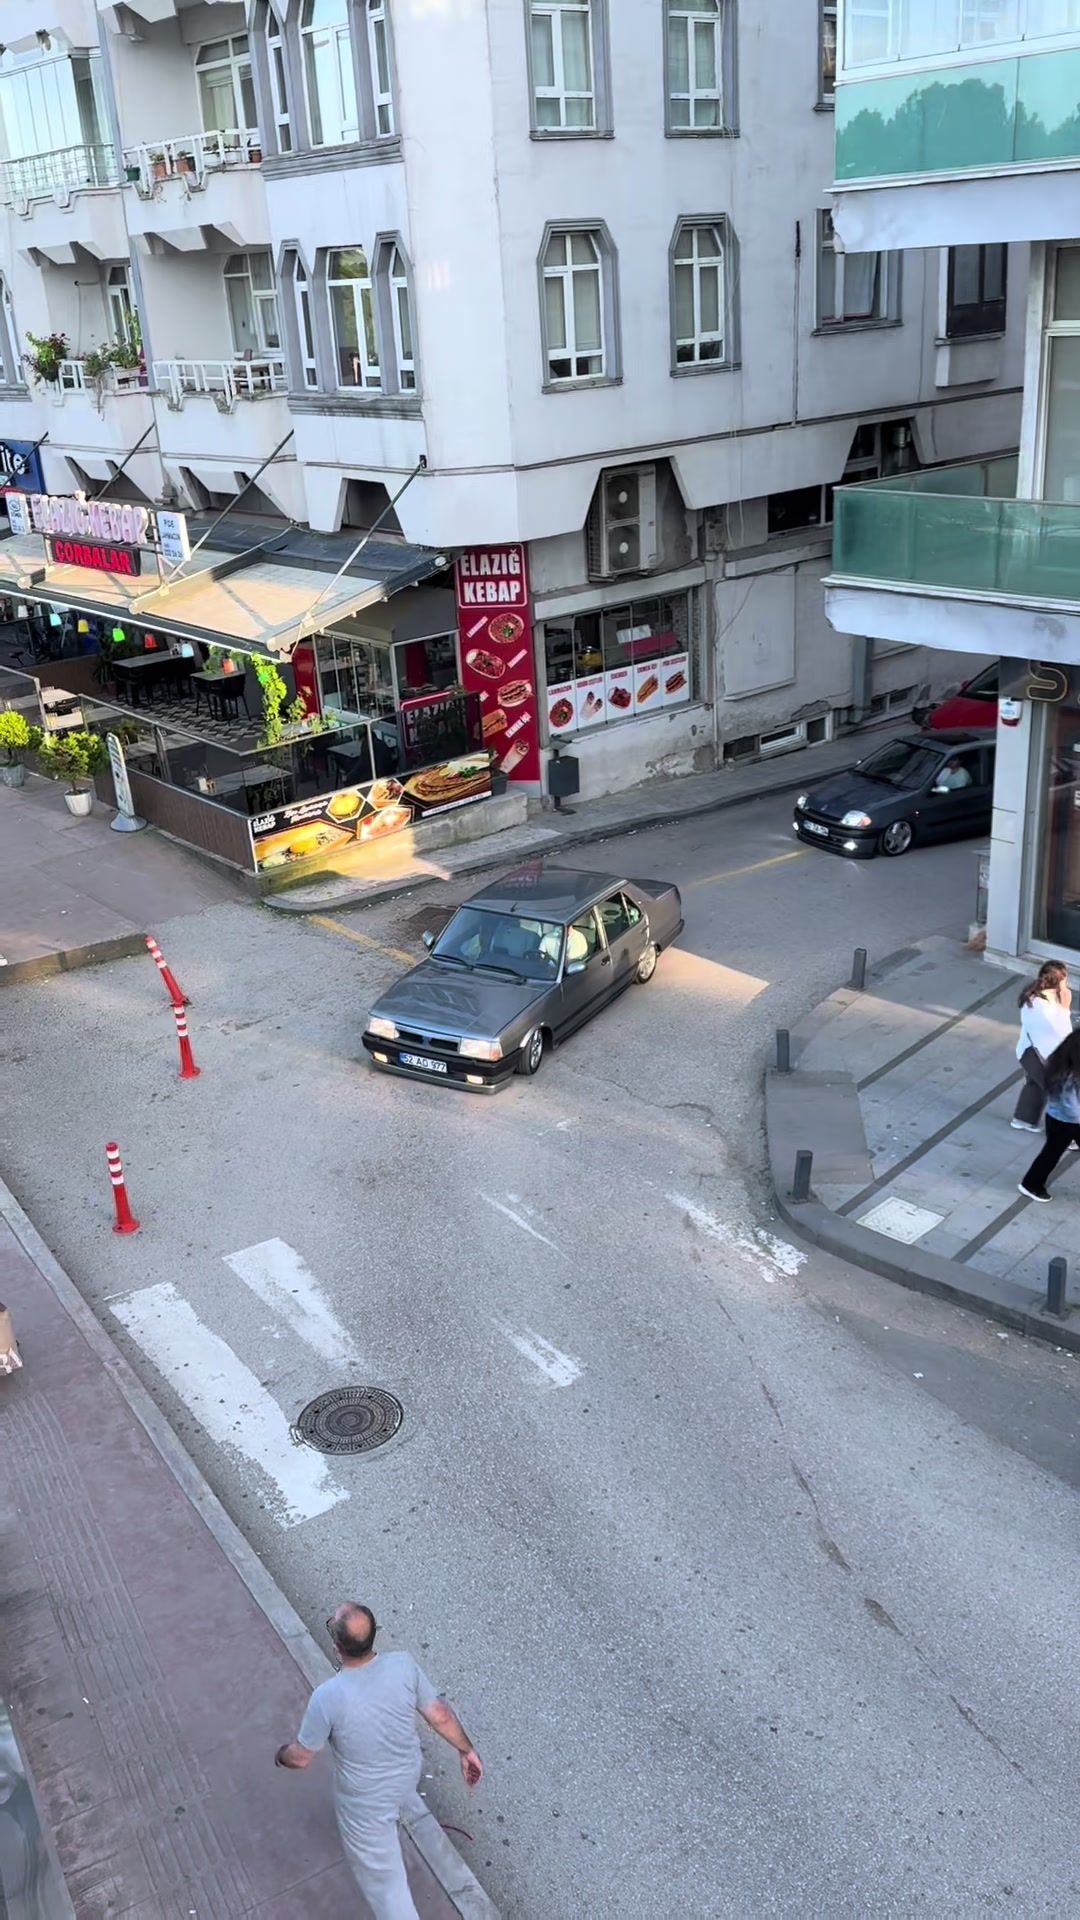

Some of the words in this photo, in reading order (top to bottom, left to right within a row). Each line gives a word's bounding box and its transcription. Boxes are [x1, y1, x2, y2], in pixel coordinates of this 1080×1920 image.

[88, 501, 149, 545] KEBAP
[460, 549, 521, 577] ELAZIĞ
[463, 581, 521, 603] KEBAP
[403, 1054, 413, 1064] 52
